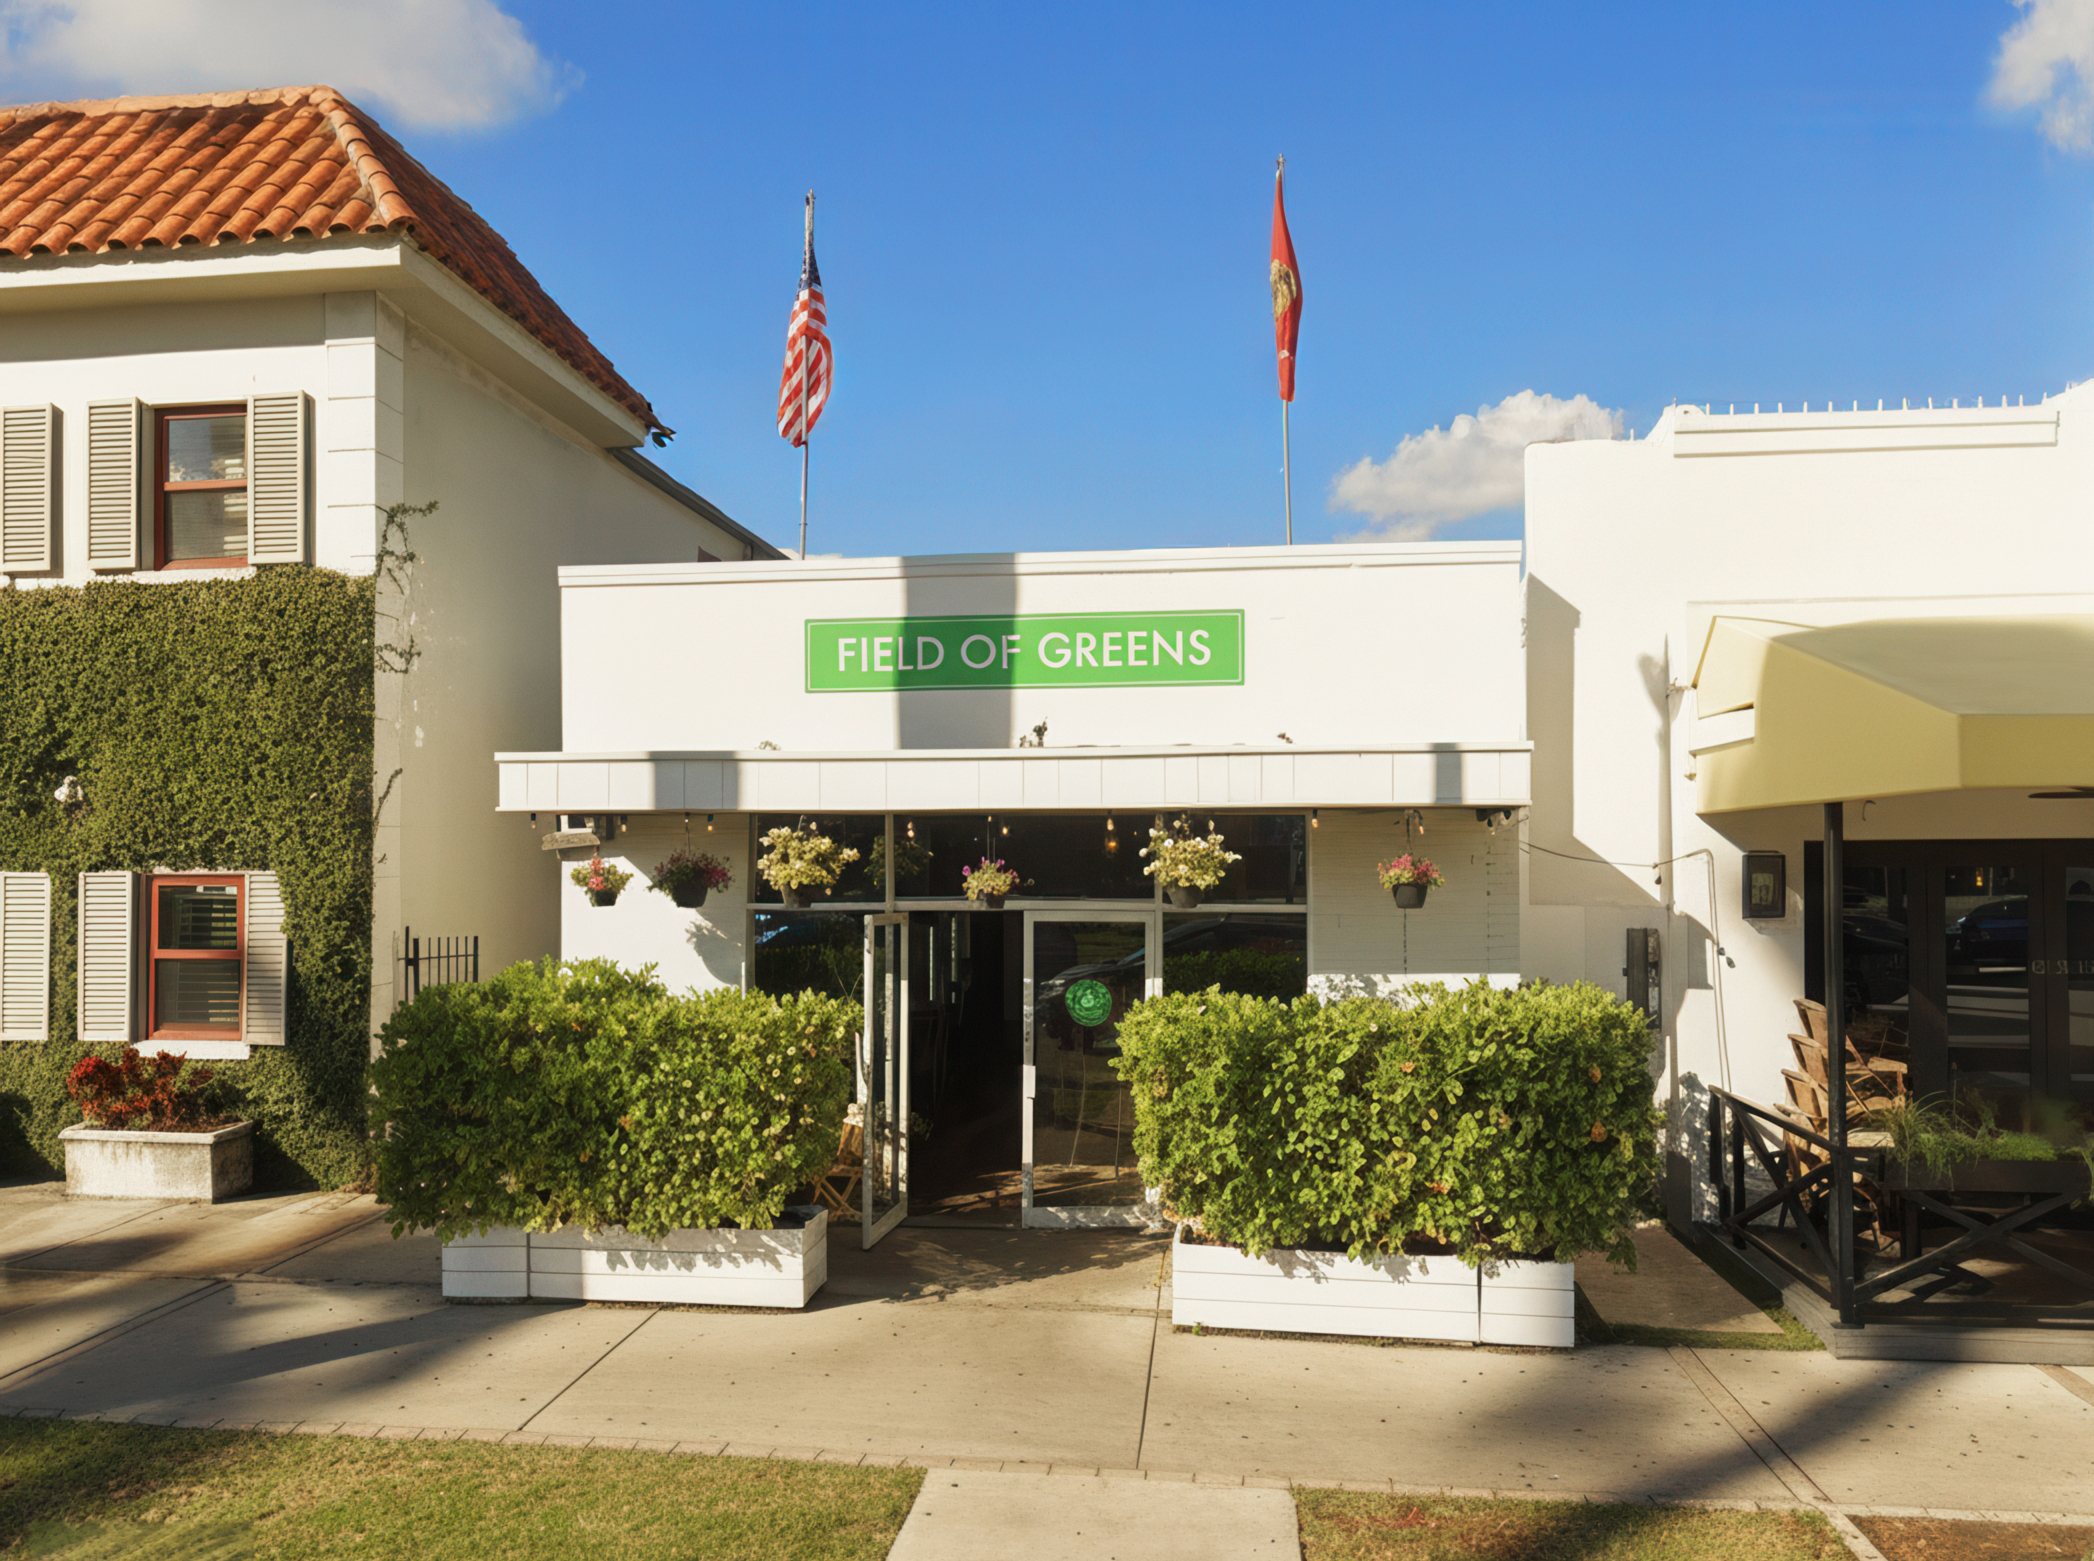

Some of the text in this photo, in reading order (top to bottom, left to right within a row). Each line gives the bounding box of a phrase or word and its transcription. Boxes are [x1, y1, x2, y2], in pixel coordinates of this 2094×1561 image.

[837, 629, 1212, 672] FIELD OF GREENS
